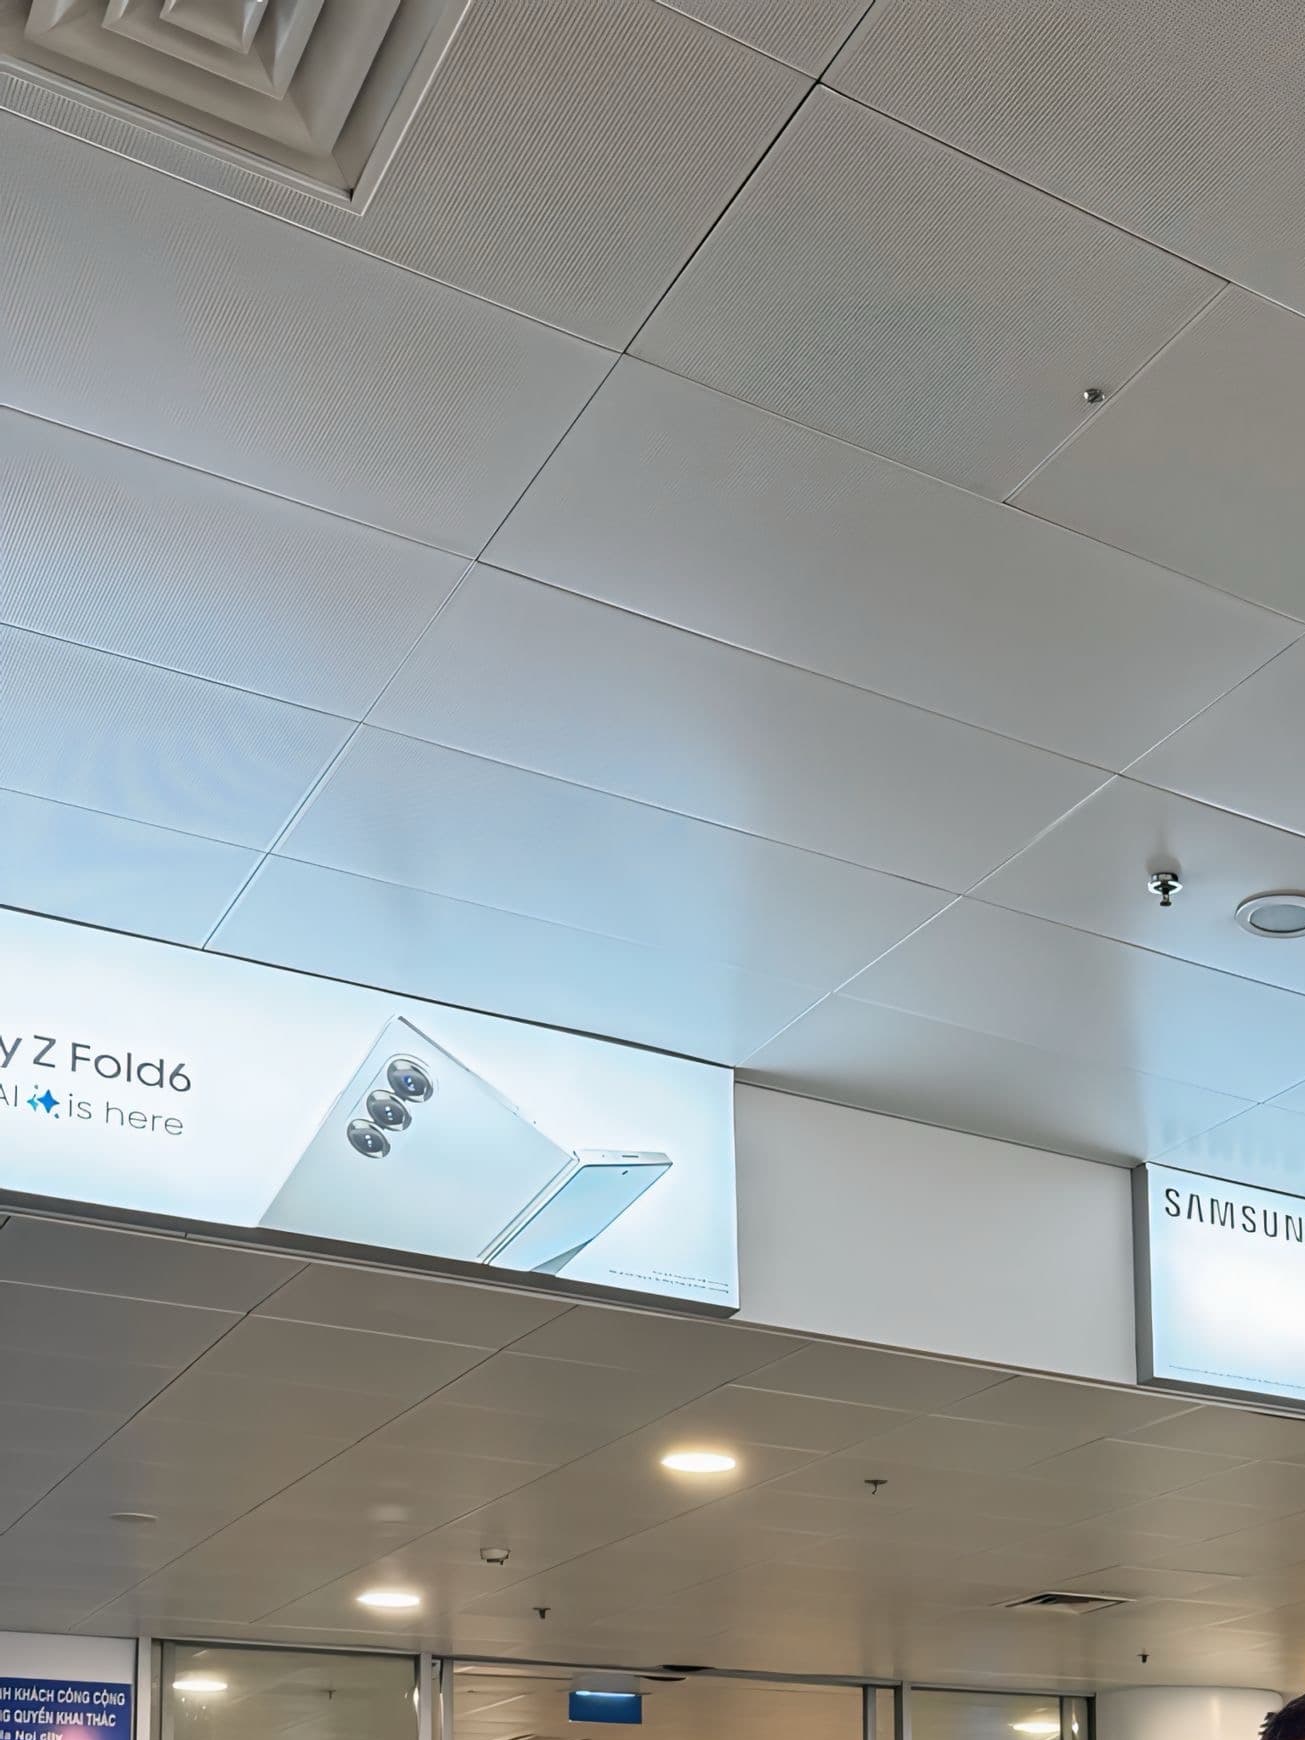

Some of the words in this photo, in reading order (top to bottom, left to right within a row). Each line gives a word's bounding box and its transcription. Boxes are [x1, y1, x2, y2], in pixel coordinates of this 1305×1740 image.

[32, 1034, 57, 1068] Z
[71, 1042, 192, 1093] Fold6
[69, 1092, 92, 1120] is
[105, 1101, 184, 1136] here
[56, 1711, 83, 1725] KHAI
